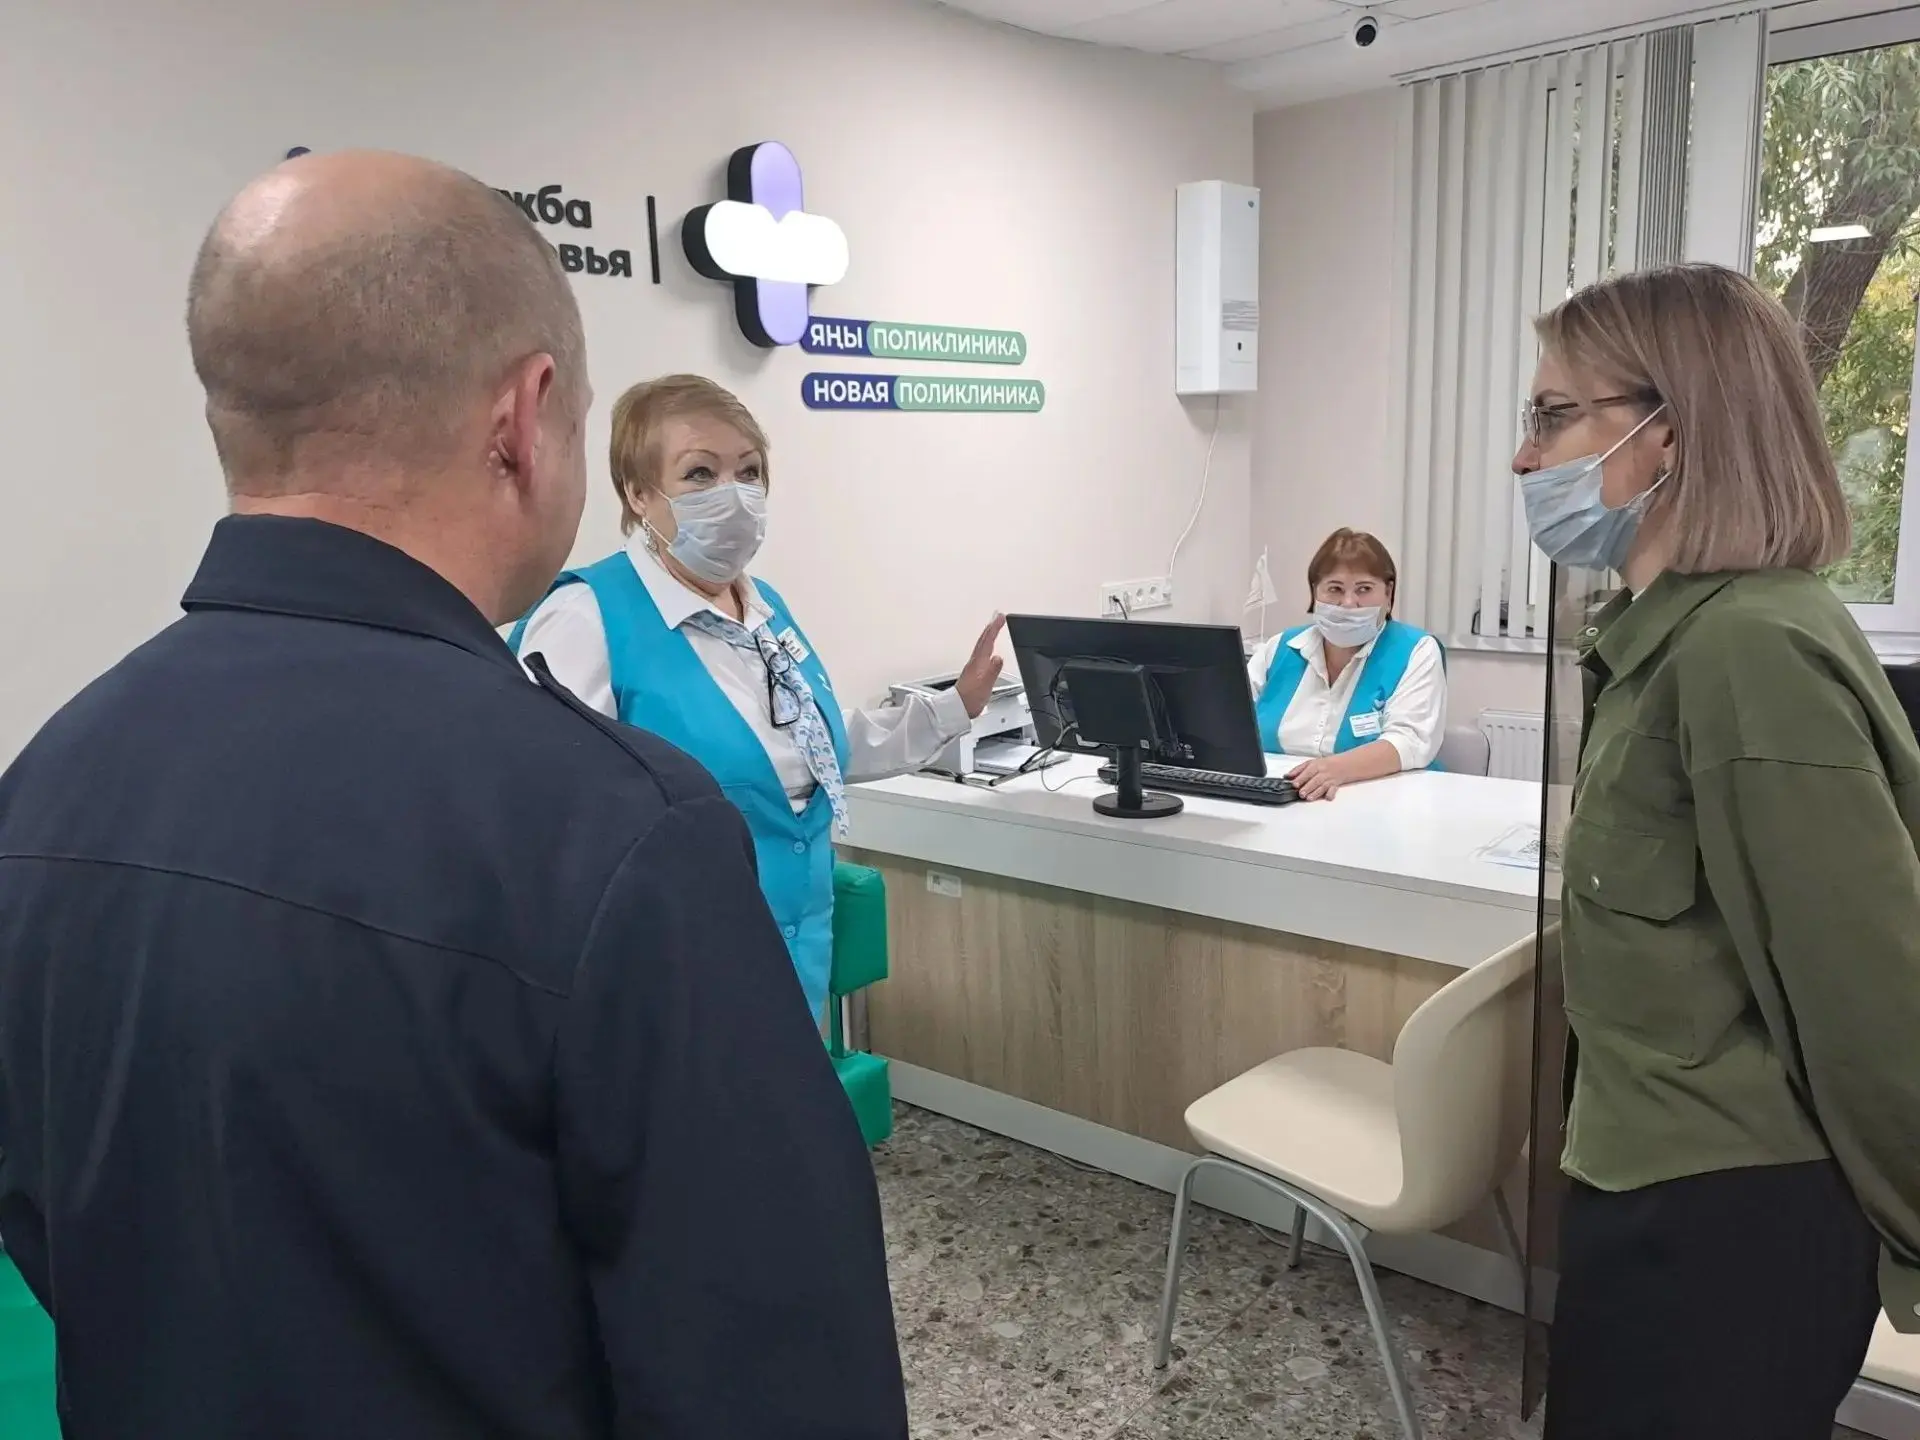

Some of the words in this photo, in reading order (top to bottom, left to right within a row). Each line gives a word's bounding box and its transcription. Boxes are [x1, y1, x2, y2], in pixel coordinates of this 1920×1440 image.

[499, 185, 592, 228] жба
[556, 243, 632, 277] вья
[810, 323, 863, 349] ЯҢЫ
[873, 327, 1021, 356] ПОЛИКЛИНИКА
[813, 379, 889, 403] НОВАЯ
[899, 382, 1040, 405] ПОЛИКЛИНИКА
